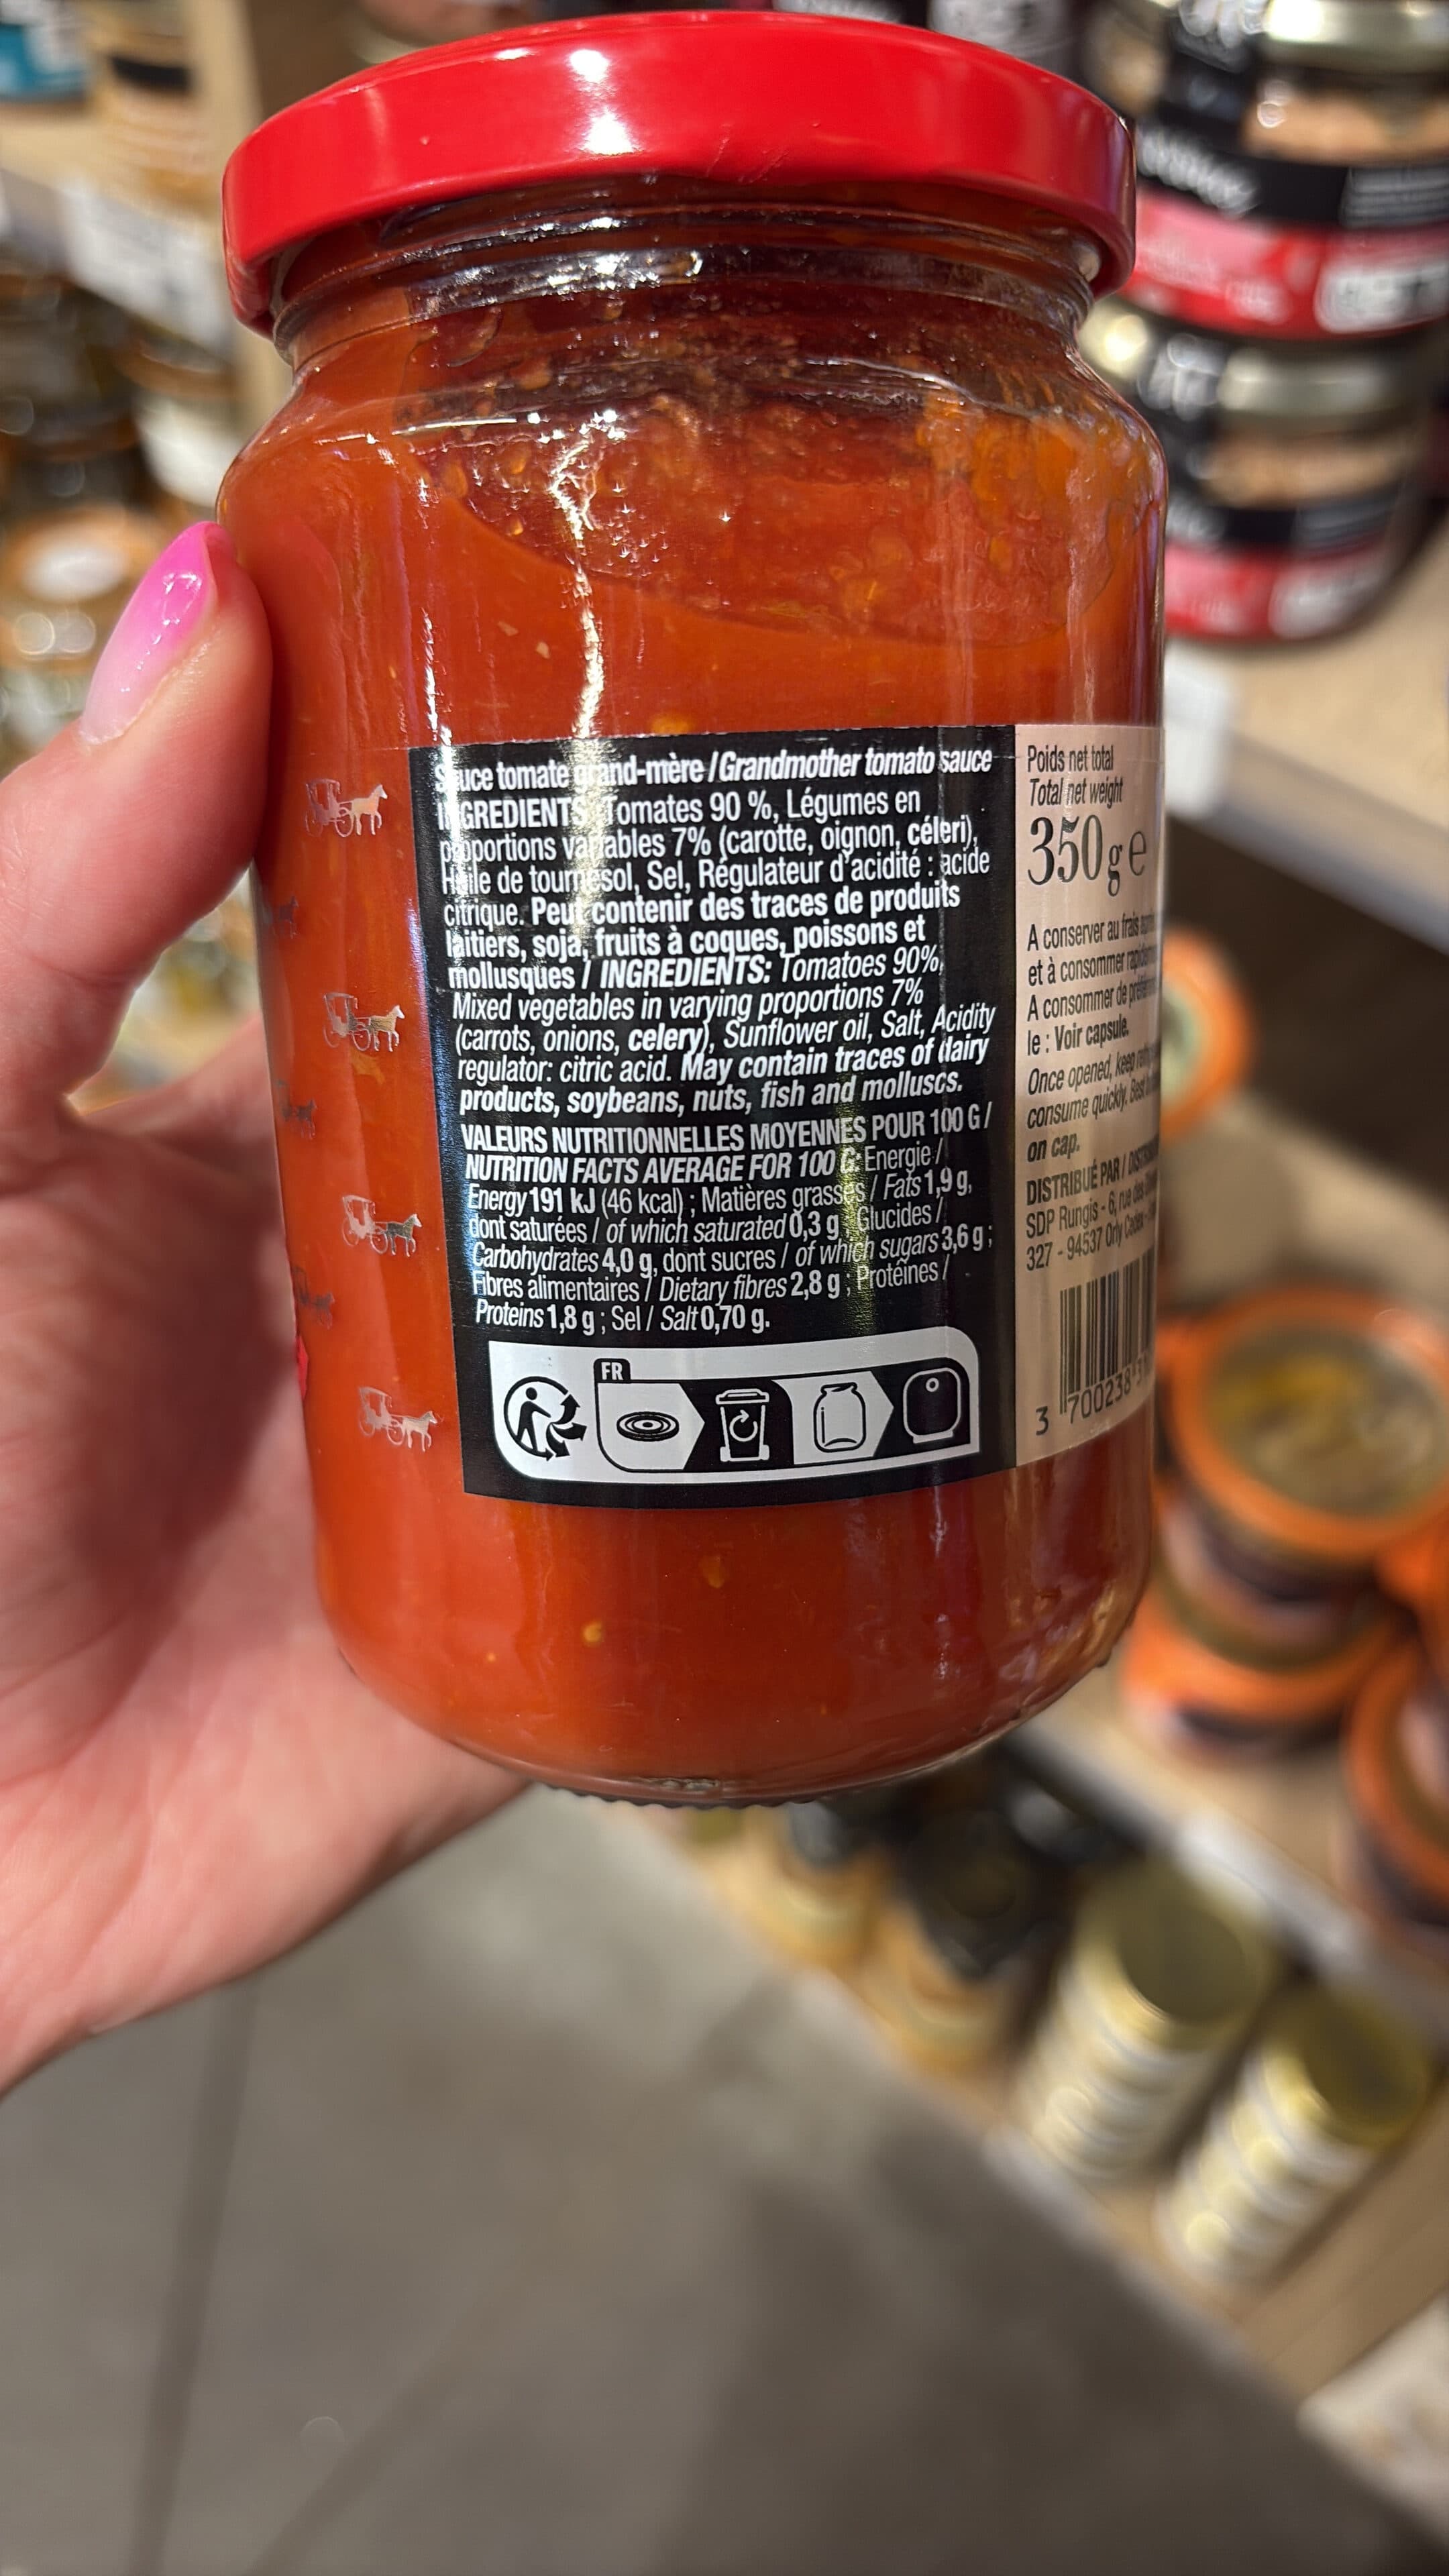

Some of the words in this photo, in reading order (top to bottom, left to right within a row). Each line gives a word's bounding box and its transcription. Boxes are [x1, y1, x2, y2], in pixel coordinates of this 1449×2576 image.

[497, 759, 569, 789] tomate
[864, 745, 935, 777] tomato
[941, 749, 992, 773] sauce
[1028, 745, 1065, 772] Poids
[1069, 745, 1087, 771] net
[1091, 745, 1114, 771] total
[606, 796, 702, 826] Tomates
[710, 791, 741, 821] 90
[787, 786, 888, 823] Légumes
[895, 790, 920, 814] en
[1030, 777, 1063, 806] Total
[1090, 776, 1123, 808] weight
[671, 826, 711, 857] 7%
[718, 824, 813, 862] (carotte,
[820, 820, 900, 854] oignon,
[908, 815, 977, 846] céleri),
[497, 865, 523, 891] de
[529, 862, 640, 894] tournesol,
[647, 861, 690, 893] Sel,
[699, 858, 824, 894] Régulateur
[830, 848, 920, 882] d'acidité
[941, 846, 989, 875] acide
[444, 899, 525, 930] citrique.
[531, 896, 585, 925] Peut
[592, 894, 693, 924] contenir
[700, 893, 744, 921] des
[751, 890, 828, 919] traces
[835, 885, 863, 916] de
[871, 879, 960, 919] produits
[446, 928, 527, 962] laitiers,
[533, 927, 589, 963] soja,
[596, 926, 661, 957] fruits
[667, 924, 681, 955] à
[690, 928, 786, 959] coques,
[794, 919, 897, 955] poissons
[904, 915, 926, 942] et
[1043, 922, 1104, 950] conserver
[449, 962, 576, 994] mollusques
[600, 955, 772, 989] INGREDIENTS:
[780, 954, 885, 982] Tomatoes
[894, 945, 943, 975] 90%,
[1028, 960, 1042, 986] et
[1048, 957, 1056, 984] à
[1061, 953, 1124, 982] consommer
[453, 993, 511, 1020] Mixed
[519, 991, 634, 1026] vegetables
[642, 991, 661, 1019] in
[670, 989, 752, 1023] varying
[759, 983, 883, 1022] proportions
[892, 977, 923, 1006] 7%
[1027, 994, 1038, 1022] A
[1043, 988, 1114, 1019] consommer
[1116, 981, 1126, 1006] de
[455, 1024, 535, 1055] (carrots,
[543, 1025, 619, 1055] onions,
[629, 1022, 714, 1057] celery),
[724, 1016, 838, 1049] Sunflower
[843, 1014, 871, 1044] oil,
[881, 1010, 925, 1040] Salt,
[932, 1003, 996, 1034] Acidity
[1028, 1030, 1040, 1056] le
[1055, 1023, 1082, 1051] Voir
[1086, 1014, 1128, 1048] capsule.
[458, 1055, 551, 1086] regulator:
[560, 1057, 612, 1082] citric
[620, 1055, 671, 1081] acid.
[681, 1053, 732, 1085] May
[739, 1046, 827, 1079] contain
[835, 1046, 904, 1073] traces
[912, 1037, 934, 1066] of
[938, 1036, 989, 1065] dairy
[1028, 1068, 1064, 1095] Once
[1068, 1054, 1112, 1091] opened,
[1116, 1052, 1135, 1077] keep
[460, 1085, 559, 1118] products,
[568, 1088, 684, 1118] soybeans,
[693, 1085, 751, 1114] nuts,
[761, 1079, 804, 1109] fish
[811, 1075, 855, 1106] and
[861, 1072, 963, 1102] molluscs.
[1028, 1097, 1089, 1129] consume
[1092, 1081, 1127, 1120] quickly.
[461, 1124, 547, 1154] VALEURS
[553, 1125, 743, 1154] NUTRITIONNELLES
[751, 1117, 865, 1150] MOYENNES
[873, 1110, 924, 1140] POUR
[930, 1108, 963, 1134] 100
[1028, 1140, 1047, 1162] on
[1051, 1134, 1079, 1159] cap.
[466, 1155, 567, 1183] NUTRITION
[572, 1157, 639, 1183] FACTS
[643, 1155, 743, 1183] AVERAGE
[749, 1152, 792, 1181] FOR
[799, 1150, 835, 1177] 100
[865, 1141, 930, 1174] Energie
[1027, 1159, 1097, 1205] DISTRIBUÉ
[1100, 1157, 1119, 1186] PAR
[470, 1187, 527, 1216] Energy
[529, 1187, 566, 1213] 191
[571, 1187, 596, 1213] kJ
[601, 1187, 631, 1219] (46
[638, 1186, 683, 1219] kcal)
[702, 1185, 786, 1212] Matières
[793, 1183, 865, 1215] grasses
[884, 1173, 921, 1200] Fats
[924, 1167, 952, 1199] 1,9
[957, 1169, 972, 1194] g,
[471, 1216, 507, 1240] dont
[510, 1216, 588, 1243] saturées
[607, 1218, 625, 1244] of
[631, 1217, 688, 1244] which
[694, 1213, 784, 1243] saturated
[790, 1211, 820, 1243] 0,3
[857, 1204, 931, 1233] Glucides
[1026, 1209, 1055, 1238] SDP
[1059, 1197, 1098, 1230] Rungis
[473, 1242, 598, 1276] Carbohydrates
[602, 1247, 633, 1275] 4,0
[640, 1251, 657, 1279] g,
[663, 1248, 706, 1273] dont
[711, 1250, 775, 1272] sucres
[796, 1240, 816, 1267] of
[820, 1236, 874, 1265] which
[880, 1234, 938, 1264] sugars
[942, 1226, 969, 1254] 3,6
[1027, 1242, 1053, 1271] 327
[1067, 1226, 1102, 1260] 94537
[1106, 1220, 1122, 1247] Orly
[472, 1271, 523, 1297] Fibres
[528, 1275, 640, 1301] alimentaires
[659, 1275, 729, 1305] Dietary
[734, 1272, 787, 1301] fibres
[791, 1270, 822, 1301] 2,8
[858, 1258, 938, 1291] Protéines
[476, 1299, 544, 1329] Proteins
[547, 1305, 576, 1334] 1,8
[612, 1305, 641, 1331] Sel
[661, 1305, 698, 1330] Salt
[701, 1305, 745, 1336] 0,70
[752, 1307, 769, 1334] g.
[602, 1362, 623, 1381] FR
[1036, 1406, 1048, 1436] 3
